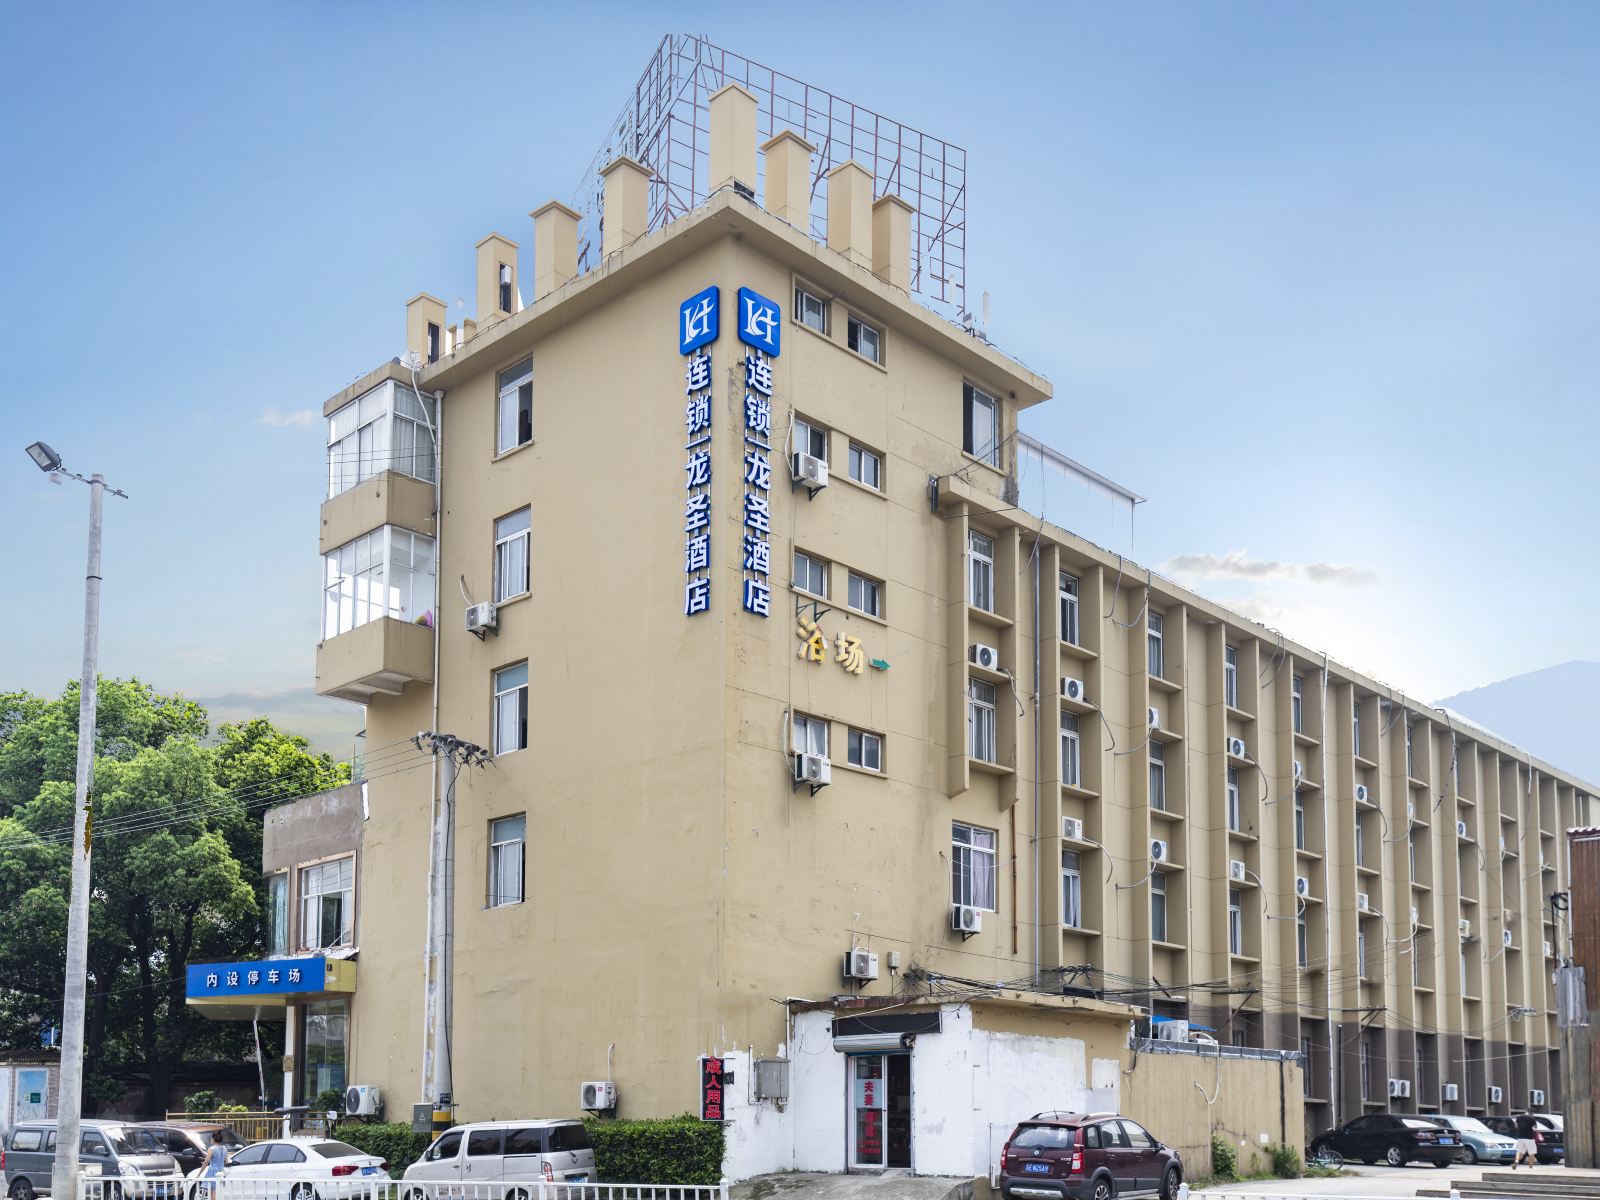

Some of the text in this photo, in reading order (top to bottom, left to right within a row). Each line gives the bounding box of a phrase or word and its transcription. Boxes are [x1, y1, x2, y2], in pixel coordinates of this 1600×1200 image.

[206, 968, 301, 988] 内设停车场
[705, 1056, 721, 1119] 成人用品
